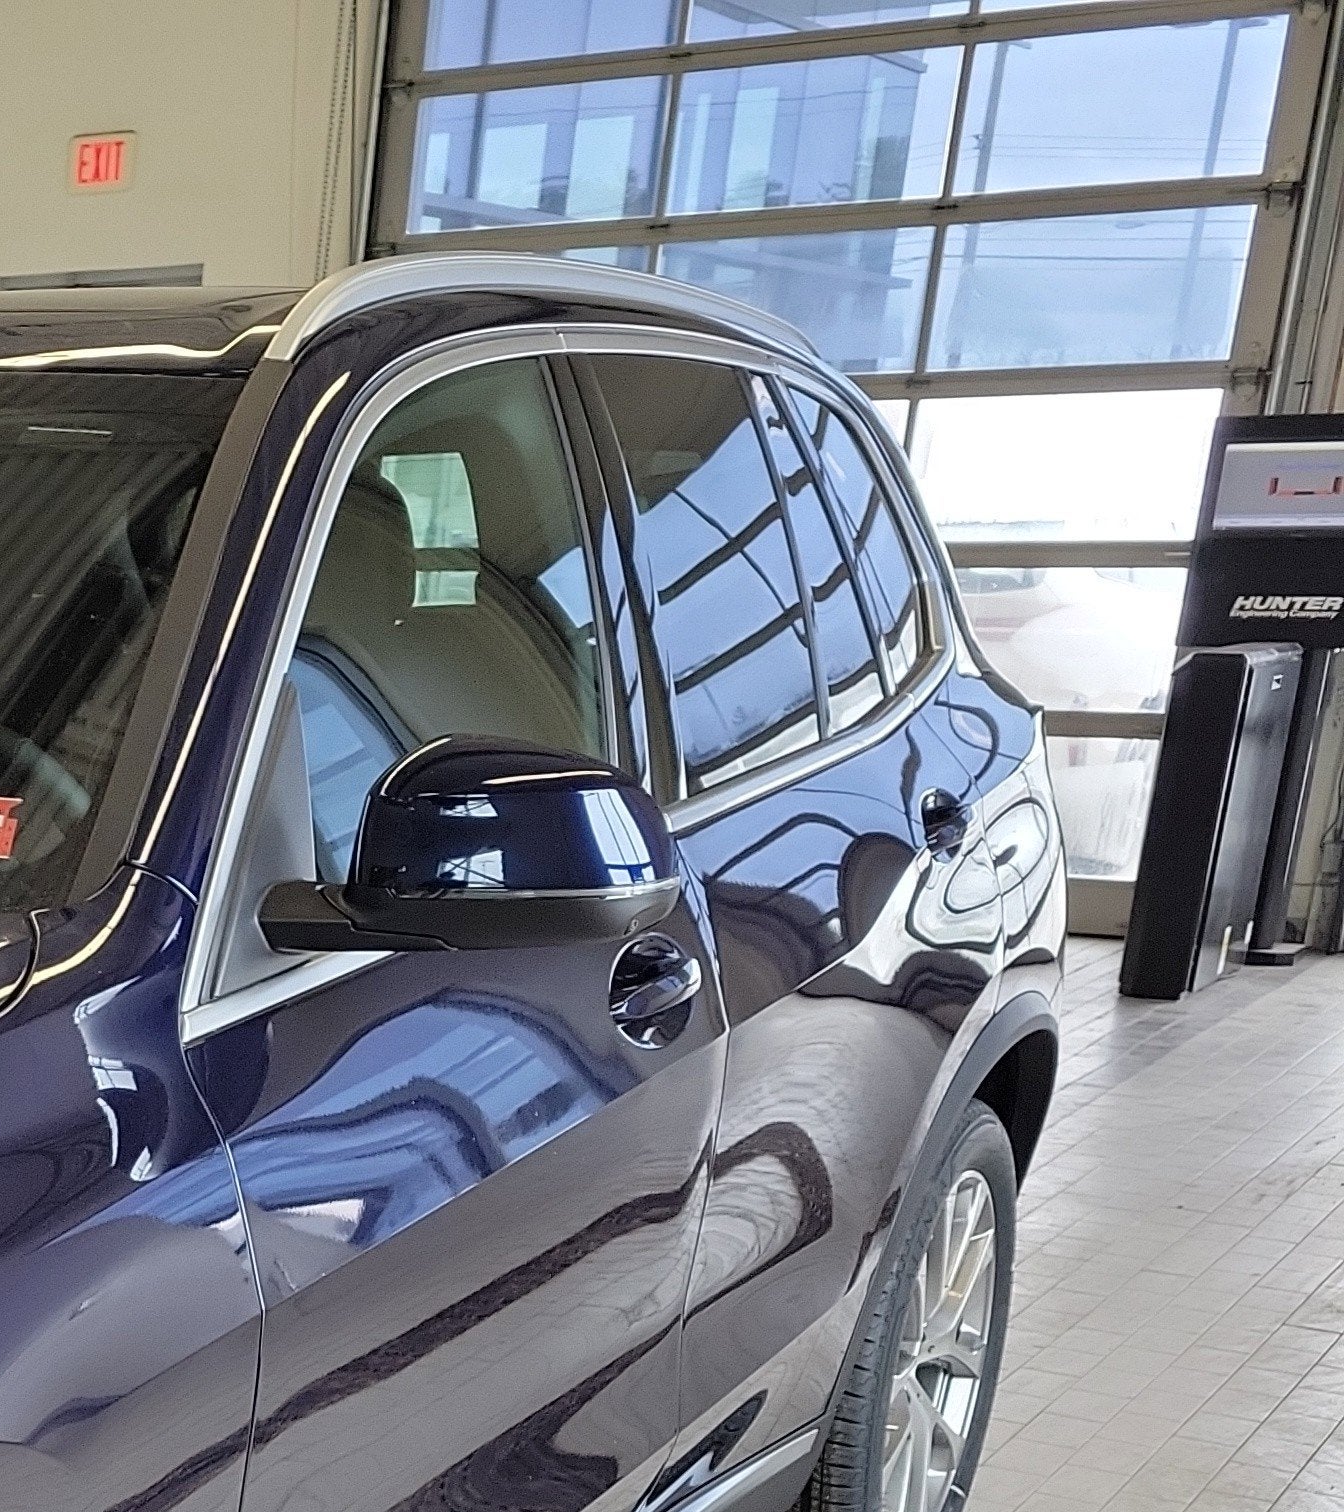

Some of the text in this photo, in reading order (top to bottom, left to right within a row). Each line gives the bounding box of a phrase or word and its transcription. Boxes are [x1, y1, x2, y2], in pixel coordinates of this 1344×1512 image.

[78, 141, 124, 184] EXIT
[1232, 596, 1344, 611] HUNTER
[1229, 609, 1340, 620] Engineering Company
